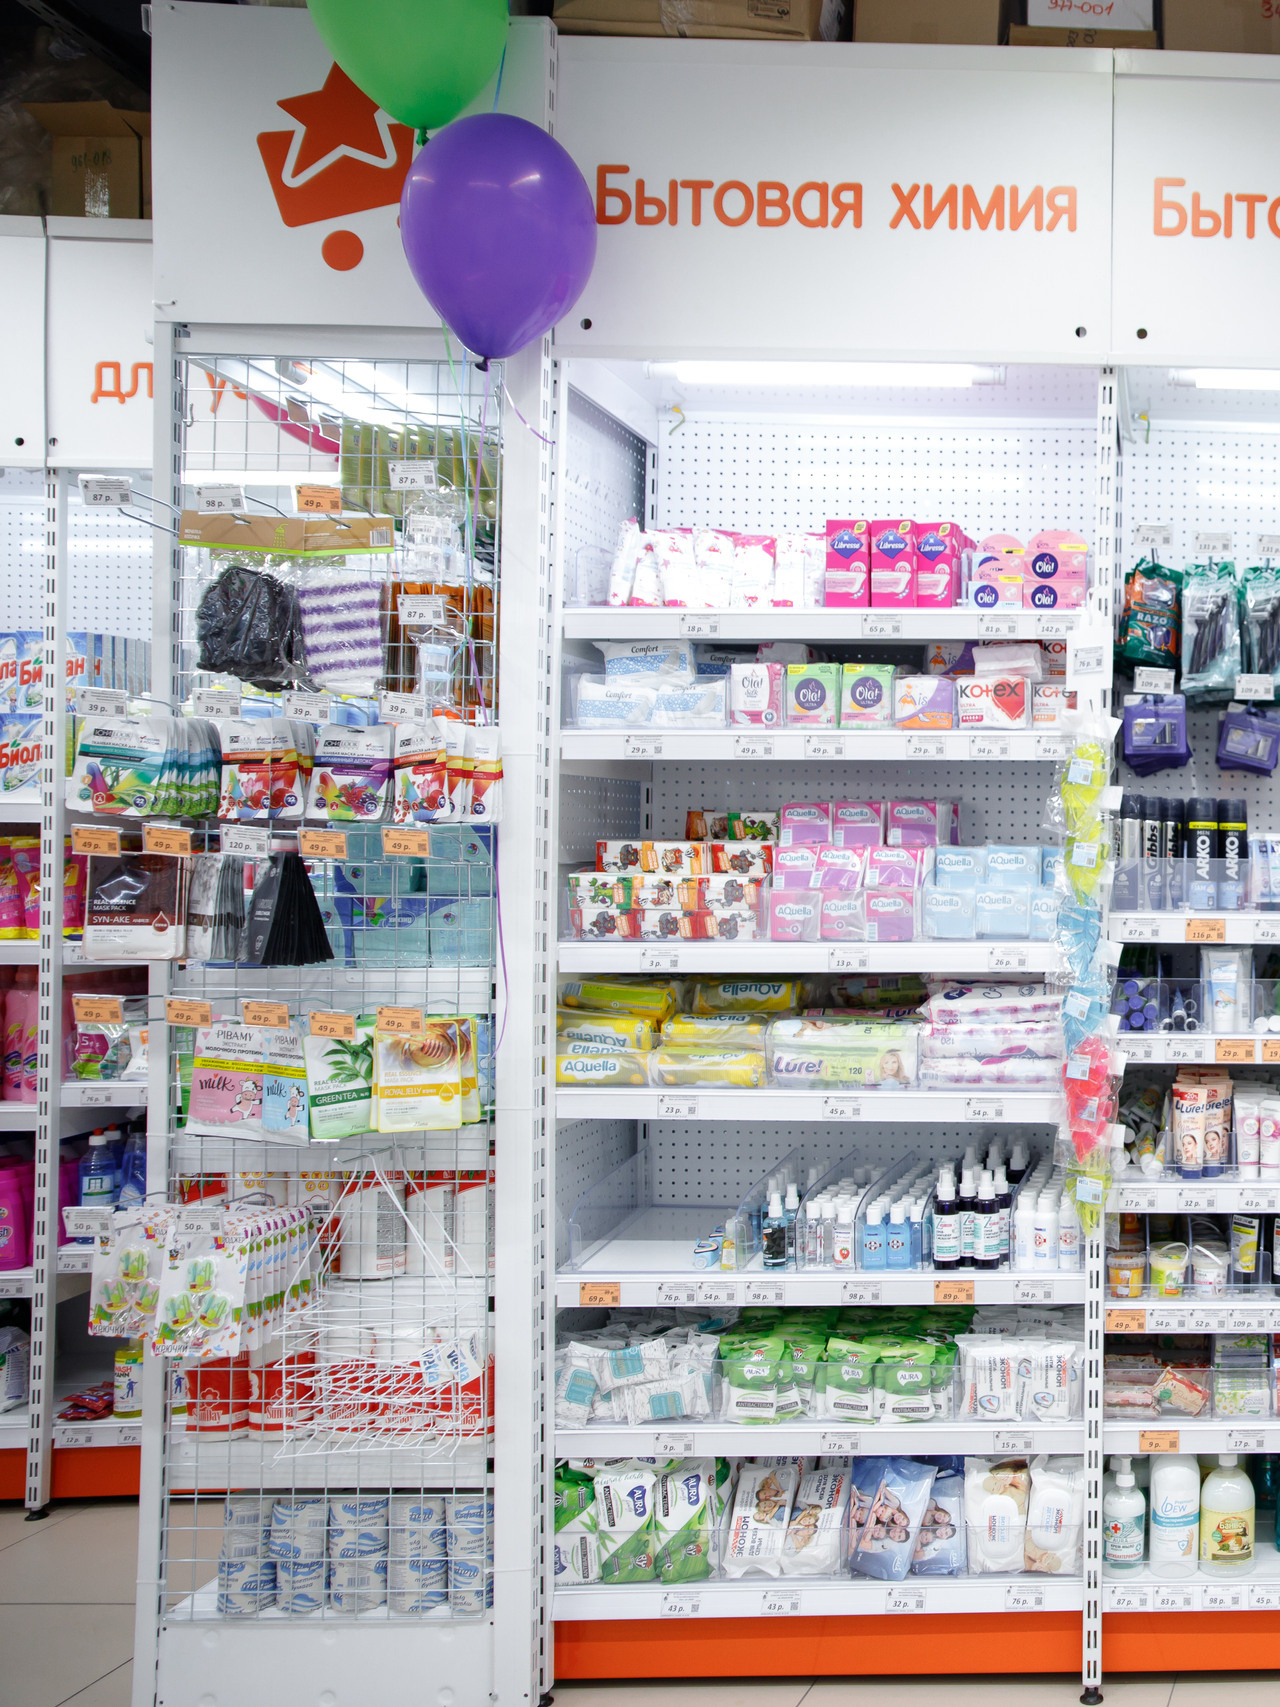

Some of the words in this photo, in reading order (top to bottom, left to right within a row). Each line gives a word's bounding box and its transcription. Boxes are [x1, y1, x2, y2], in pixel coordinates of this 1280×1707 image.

[596, 165, 863, 229] Бытовая
[890, 181, 1078, 233] химия
[398, 476, 409, 485] 87
[92, 493, 104, 502] 87
[205, 499, 216, 508] 98
[830, 539, 863, 552] Libresse
[877, 539, 908, 551] Libresse
[918, 543, 948, 555] Libresse
[687, 625, 696, 633] 18
[869, 625, 878, 633] 65
[630, 644, 659, 655] Comfort
[388, 704, 400, 713] 39
[631, 746, 641, 754] 29
[229, 841, 244, 850] 120
[391, 842, 403, 850] 49
[1196, 835, 1210, 880] ARKO
[1225, 835, 1240, 880] ARKO
[92, 915, 130, 925] SYN-AKE
[1192, 931, 1205, 939] 116
[385, 1019, 396, 1027] 49
[215, 1029, 255, 1042] PIBAMY
[562, 1059, 617, 1075] AQuella
[848, 1066, 863, 1075] 120
[384, 1088, 404, 1097] ROYAL
[404, 1087, 422, 1096] JELLY
[315, 1095, 340, 1105] GREEN
[341, 1093, 358, 1102] TEA
[665, 1106, 675, 1114] 23
[1124, 1199, 1134, 1207] 17
[184, 1223, 195, 1231] 50
[828, 1442, 837, 1450] 17
[684, 1473, 700, 1506] AURA
[631, 1485, 647, 1518] AURA
[1012, 1597, 1021, 1605] 76
[667, 1604, 678, 1612] 43
